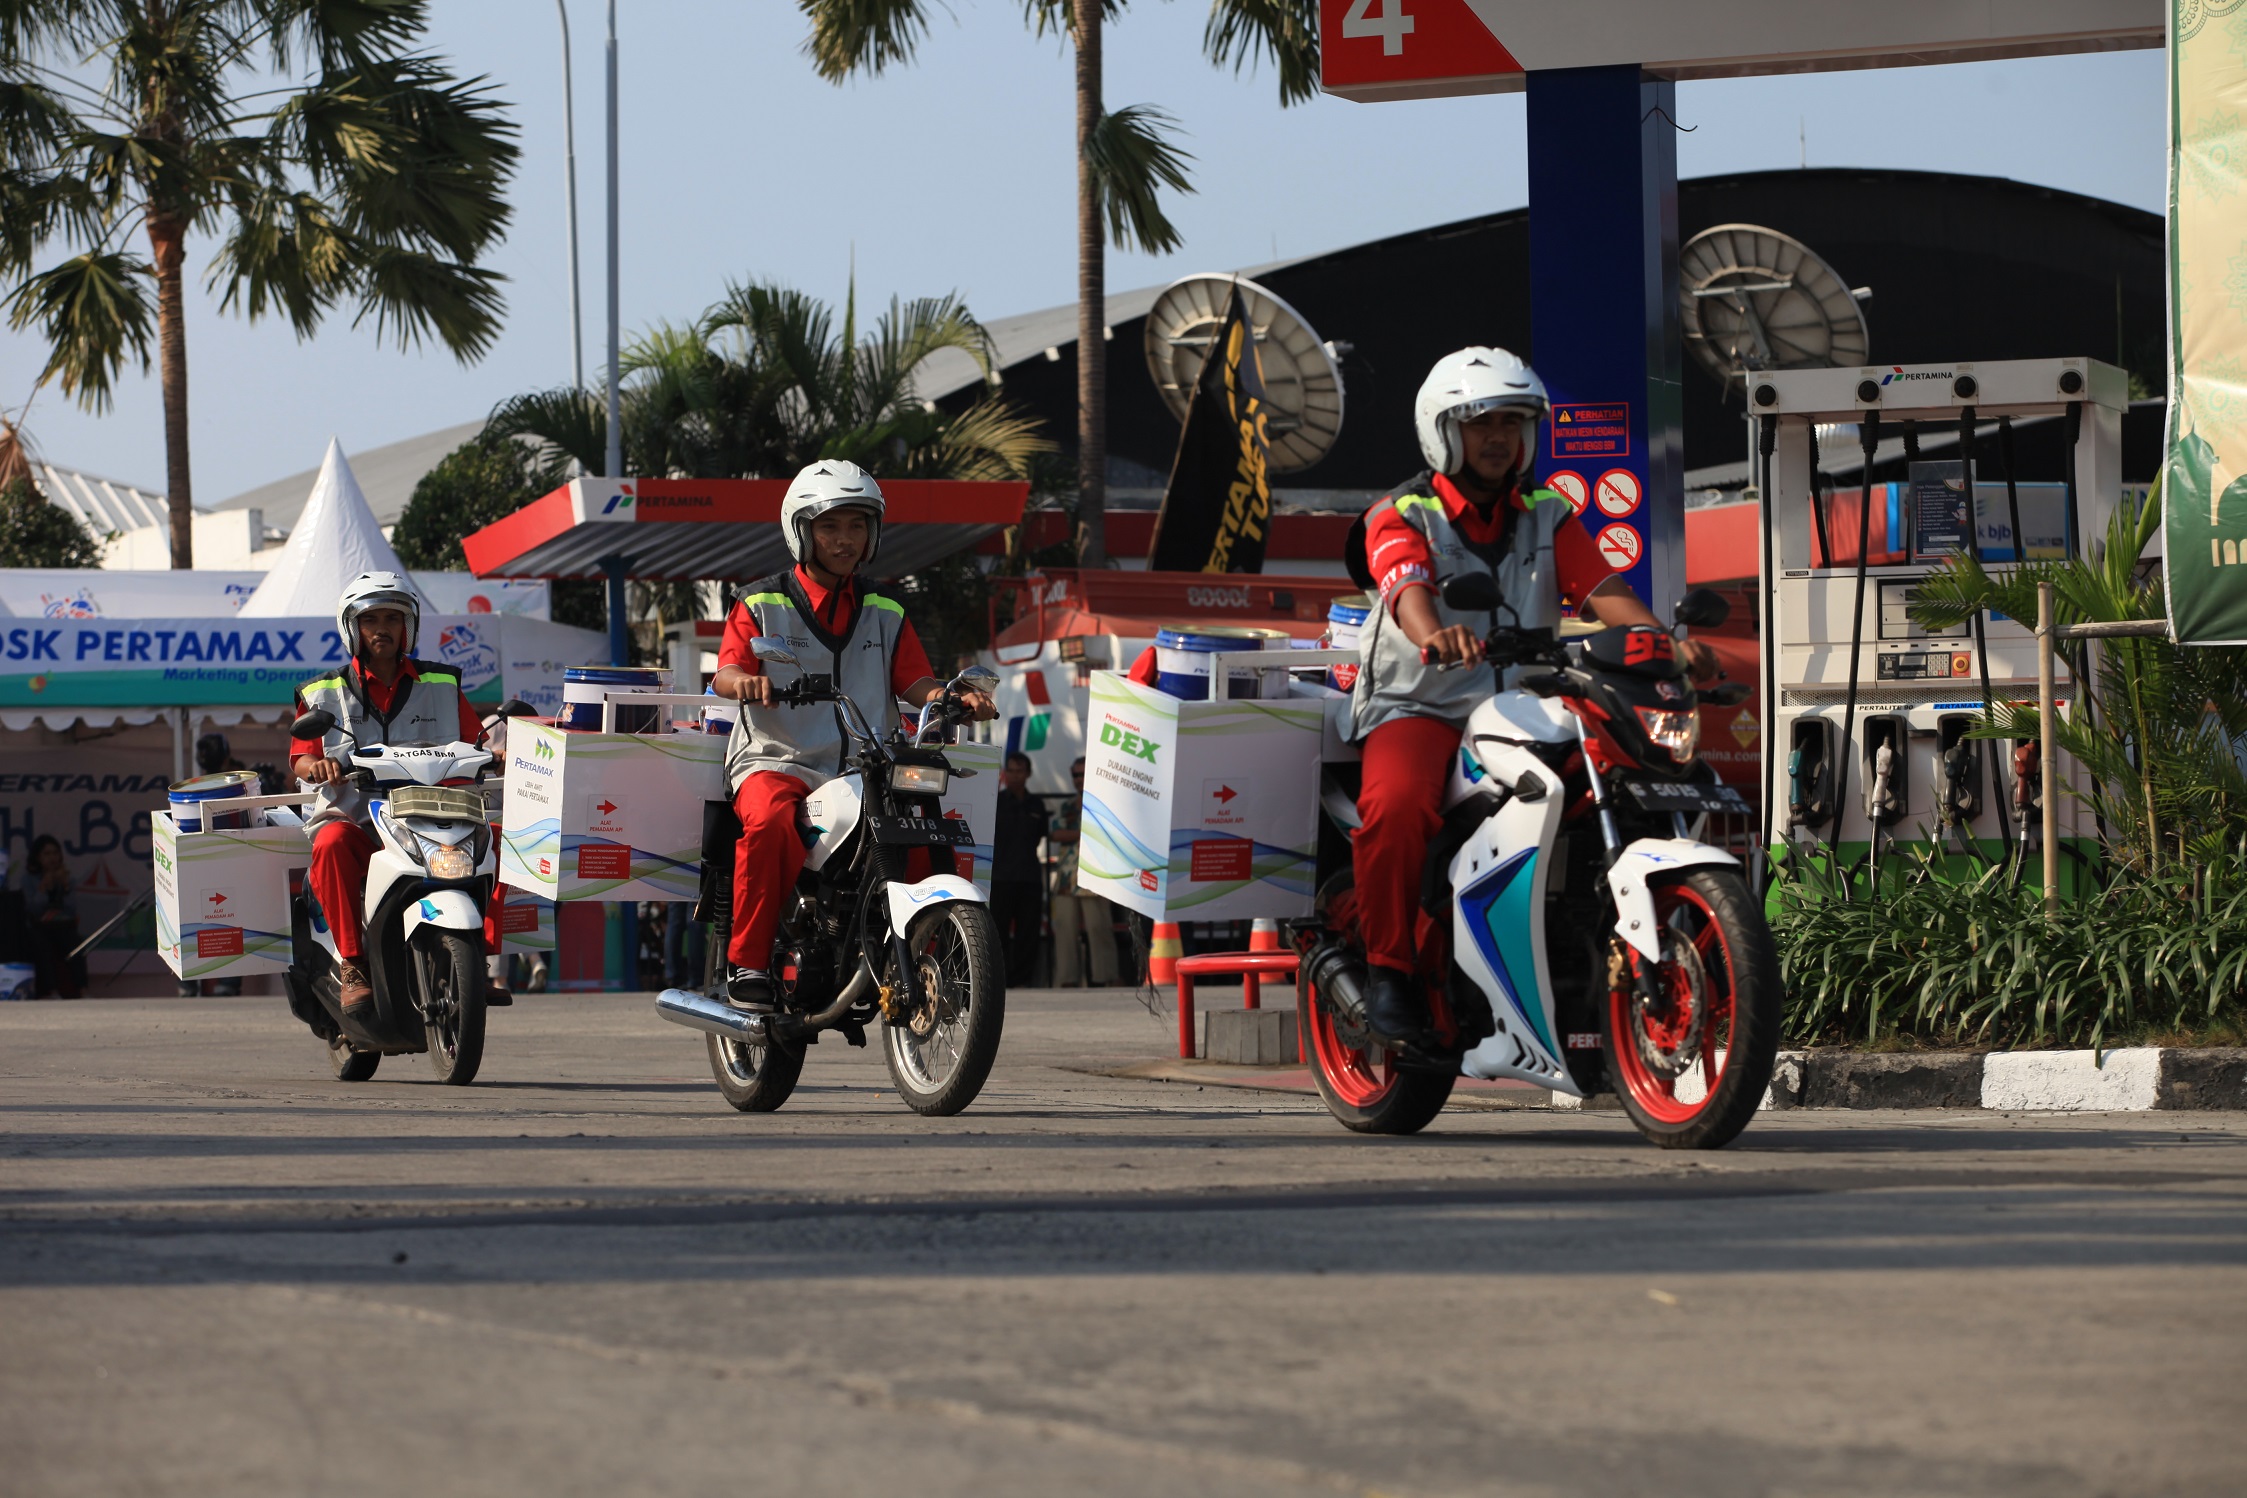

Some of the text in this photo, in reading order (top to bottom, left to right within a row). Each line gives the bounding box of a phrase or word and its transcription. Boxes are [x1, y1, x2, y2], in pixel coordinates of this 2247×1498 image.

[1342, 0, 1415, 57] 4
[1905, 371, 1953, 381] PERTAMINA
[1575, 409, 1624, 419] PERHATIAN
[637, 496, 713, 507] PERTAMINA
[1988, 523, 2012, 541] bjb
[1400, 563, 1430, 579] MAN
[76, 630, 305, 662] PERTAMAX
[163, 667, 328, 685] Marketing Operati
[1105, 712, 1141, 733] PERTAMINA
[1100, 722, 1162, 765] DEX
[393, 749, 433, 759] SATGAS
[515, 756, 554, 778] PERTAMAX
[1107, 759, 1154, 785] DURABLE ENGINE
[1096, 767, 1161, 801] EXTREME PERFORMANCE
[517, 787, 550, 805] PAKAI PERTAMAX
[871, 816, 969, 833] G 3178 E
[1205, 816, 1244, 825] PEMADAM API
[155, 845, 173, 875] DEX
